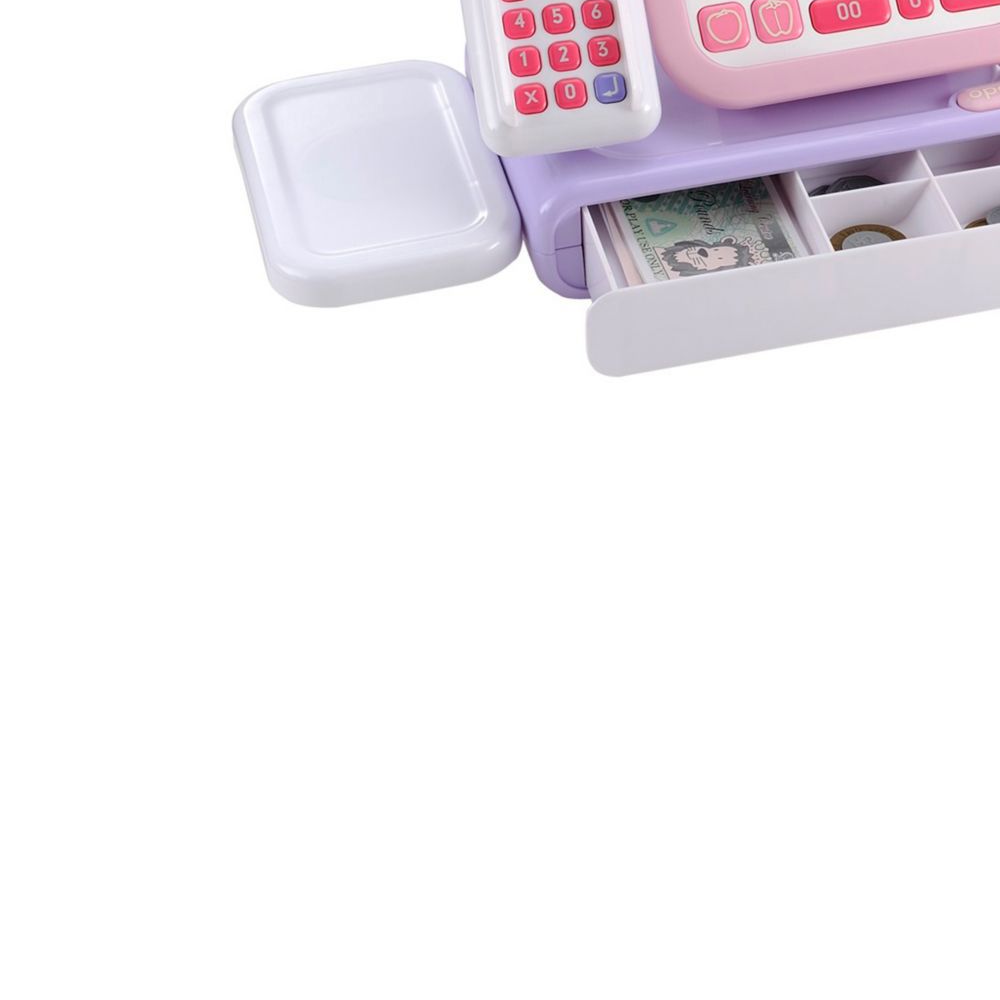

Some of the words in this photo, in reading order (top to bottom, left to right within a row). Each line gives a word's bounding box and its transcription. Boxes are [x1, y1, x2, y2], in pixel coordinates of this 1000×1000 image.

[552, 8, 564, 25] 5
[591, 3, 602, 20] 6
[836, 0, 862, 21] 00
[514, 13, 526, 28] 4
[558, 46, 569, 63] 2
[597, 41, 609, 57] 3
[519, 51, 528, 67] 1
[564, 83, 576, 99] 0
[625, 212, 645, 236] PLAY
[637, 236, 652, 253] USE
[645, 253, 664, 276] ONLY
